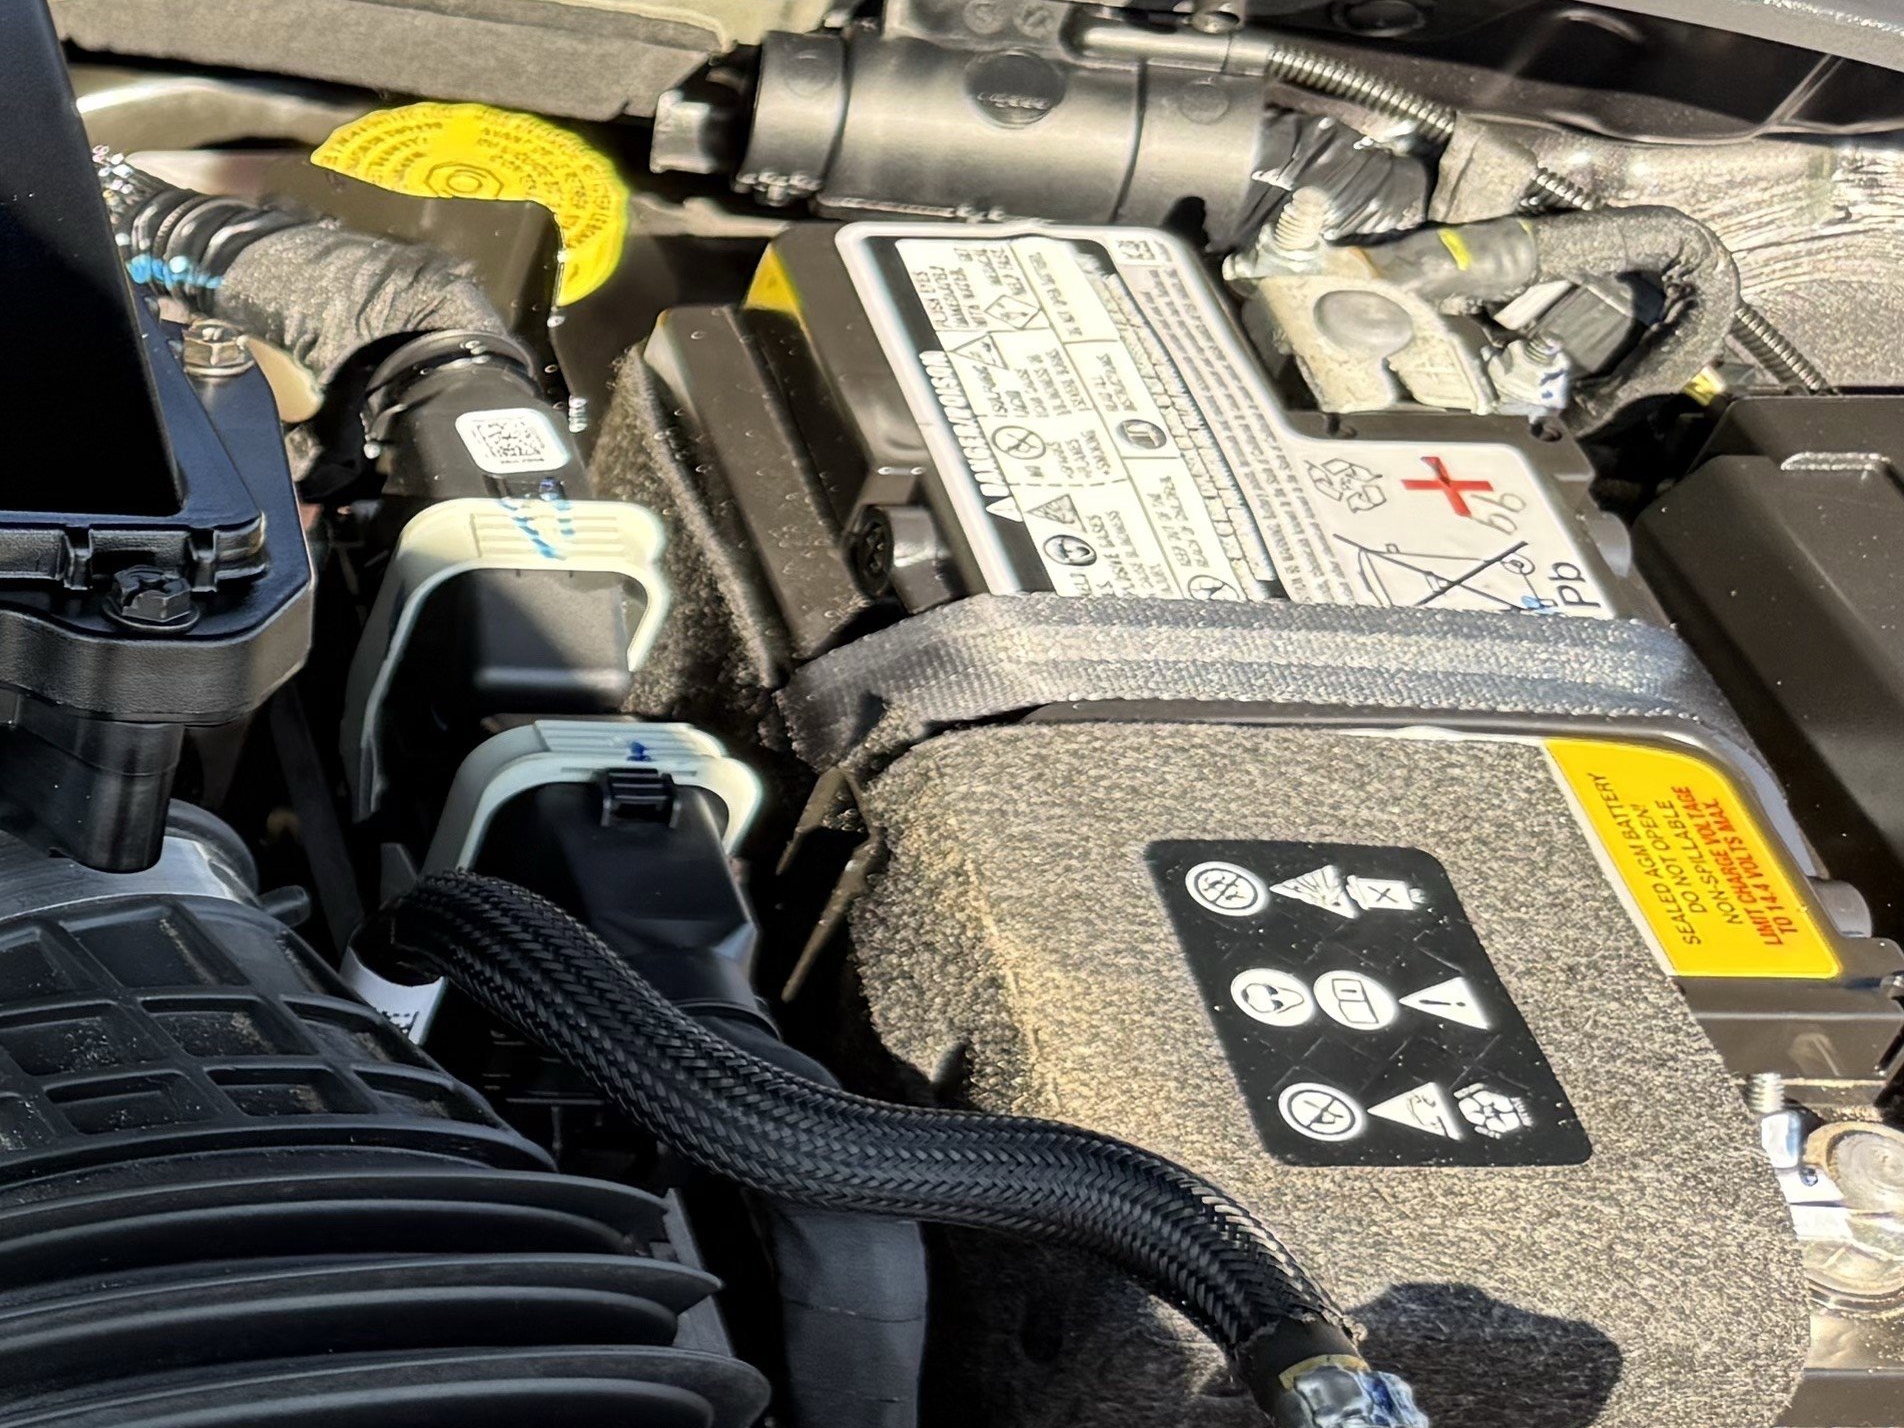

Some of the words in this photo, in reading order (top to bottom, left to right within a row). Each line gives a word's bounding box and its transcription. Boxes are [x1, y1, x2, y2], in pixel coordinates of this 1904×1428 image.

[1547, 561, 1601, 608] Pb
[1587, 772, 1641, 839] BATTERY
[1669, 785, 1722, 844] VOLTAGE
[1627, 843, 1665, 878] AGM
[1653, 798, 1744, 924] NON-SPILLABLE
[1659, 856, 1692, 885] NOT
[1707, 848, 1758, 903] CHARGE
[1721, 835, 1766, 879] VOLTS
[1649, 882, 1702, 944] SEALED
[1679, 890, 1708, 913] DO
[1742, 907, 1783, 945] LIMIT
[1771, 916, 1799, 934] TO
